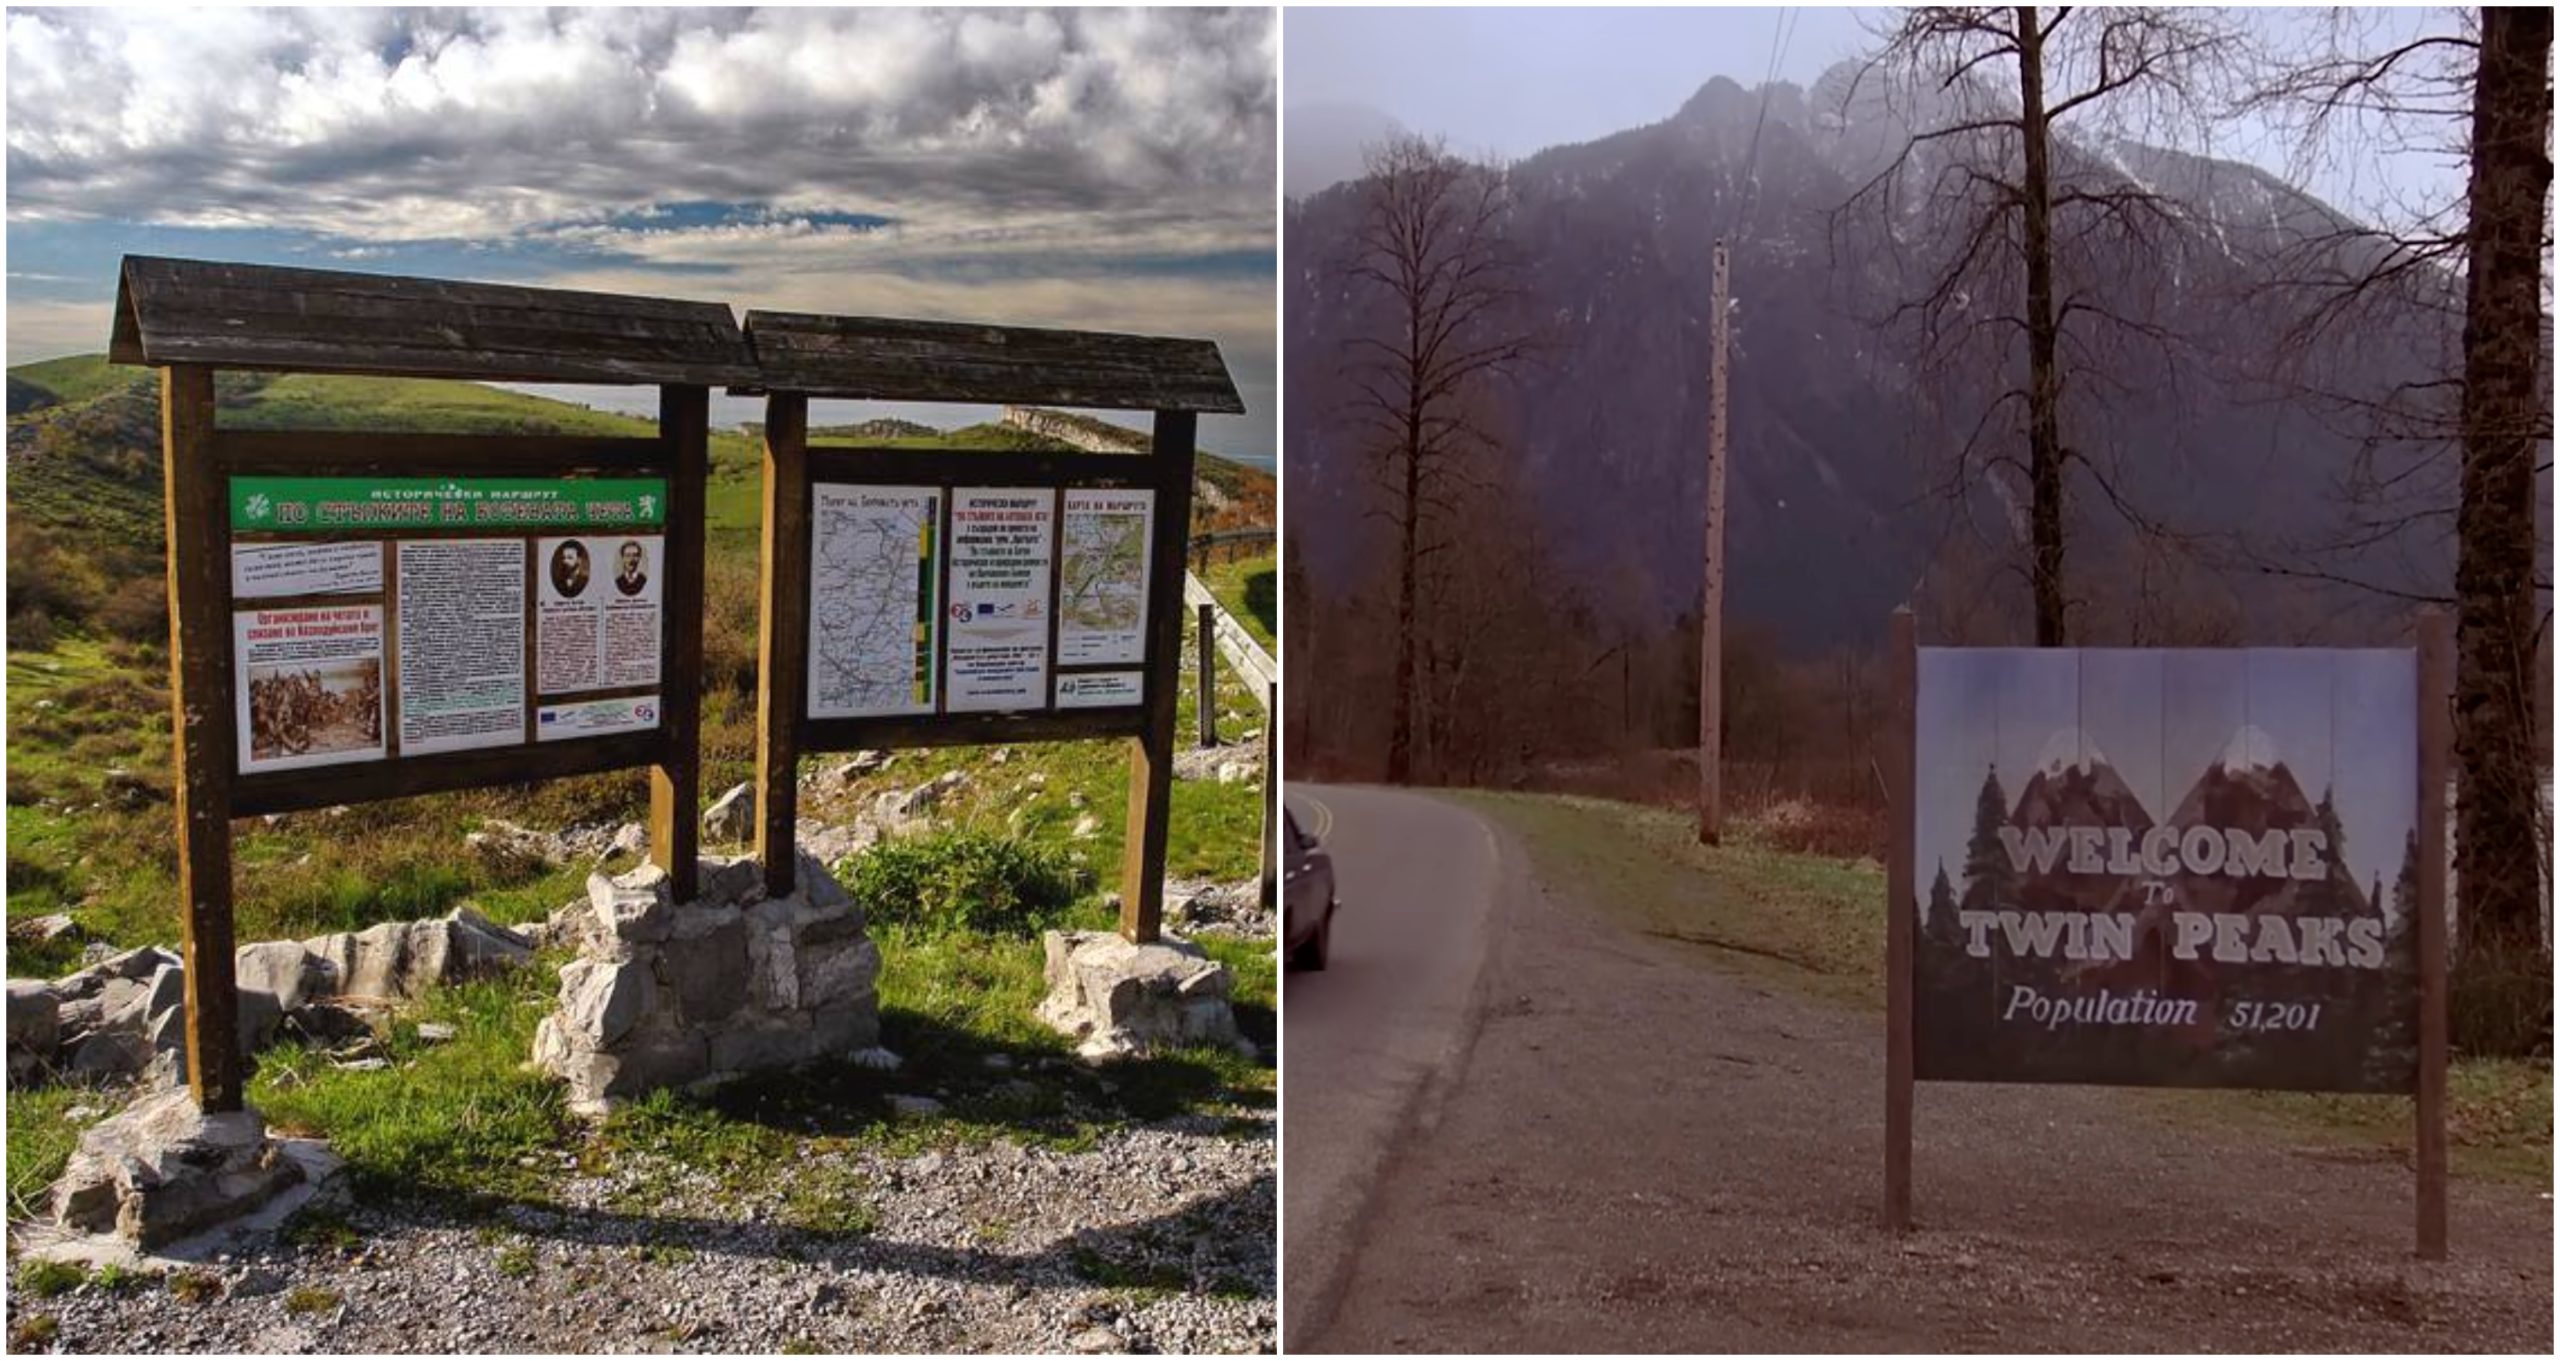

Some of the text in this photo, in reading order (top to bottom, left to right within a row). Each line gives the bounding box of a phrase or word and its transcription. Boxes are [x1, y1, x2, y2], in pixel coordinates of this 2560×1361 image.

[1999, 826, 2329, 881] WELCOME
[2142, 881, 2175, 905] To
[1960, 911, 2386, 969] TWIN PEAKS
[2004, 986, 2322, 1033] Population 51,201
